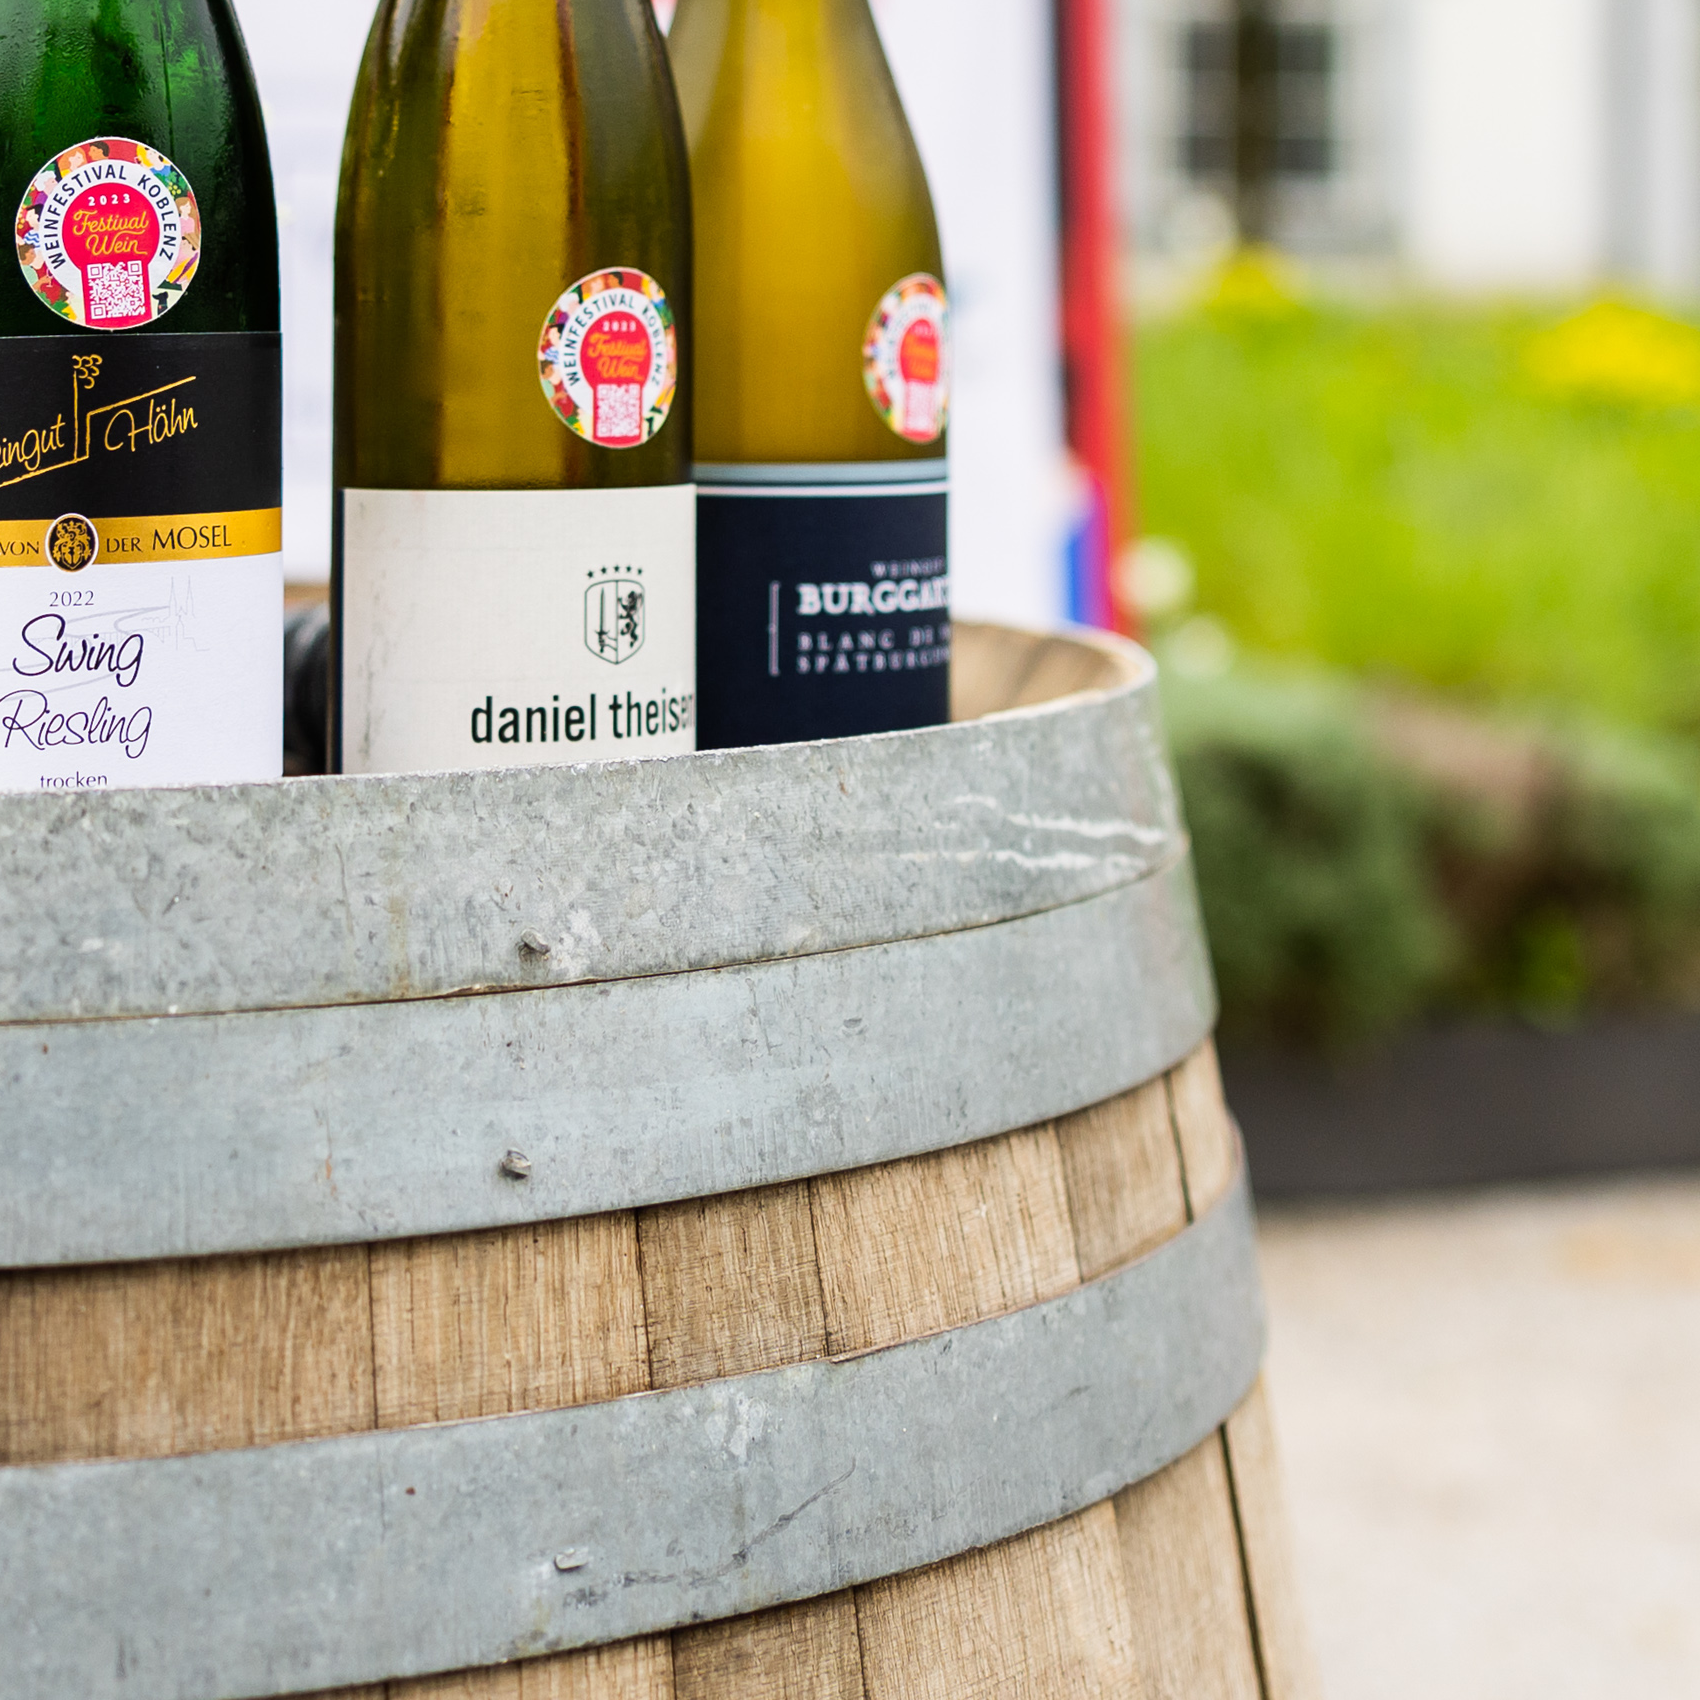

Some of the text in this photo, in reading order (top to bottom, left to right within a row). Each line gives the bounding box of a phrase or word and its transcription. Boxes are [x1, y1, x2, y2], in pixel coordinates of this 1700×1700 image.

[87, 193, 131, 207] 2023
[43, 163, 178, 270] WEINFESTIVAL KOBLENZ
[72, 208, 150, 236] Festival
[85, 229, 149, 257] Wein
[563, 292, 665, 388] WEINFESTIVAL KOBLENZ
[103, 397, 199, 453] Hähn
[0, 540, 41, 557] VON
[106, 536, 143, 555] DER
[152, 524, 233, 552] MOSEL
[49, 590, 95, 608] 2022
[12, 613, 144, 688] Swing
[797, 629, 895, 652] BLANC
[470, 693, 597, 744] daniel
[40, 771, 109, 789] trocken
